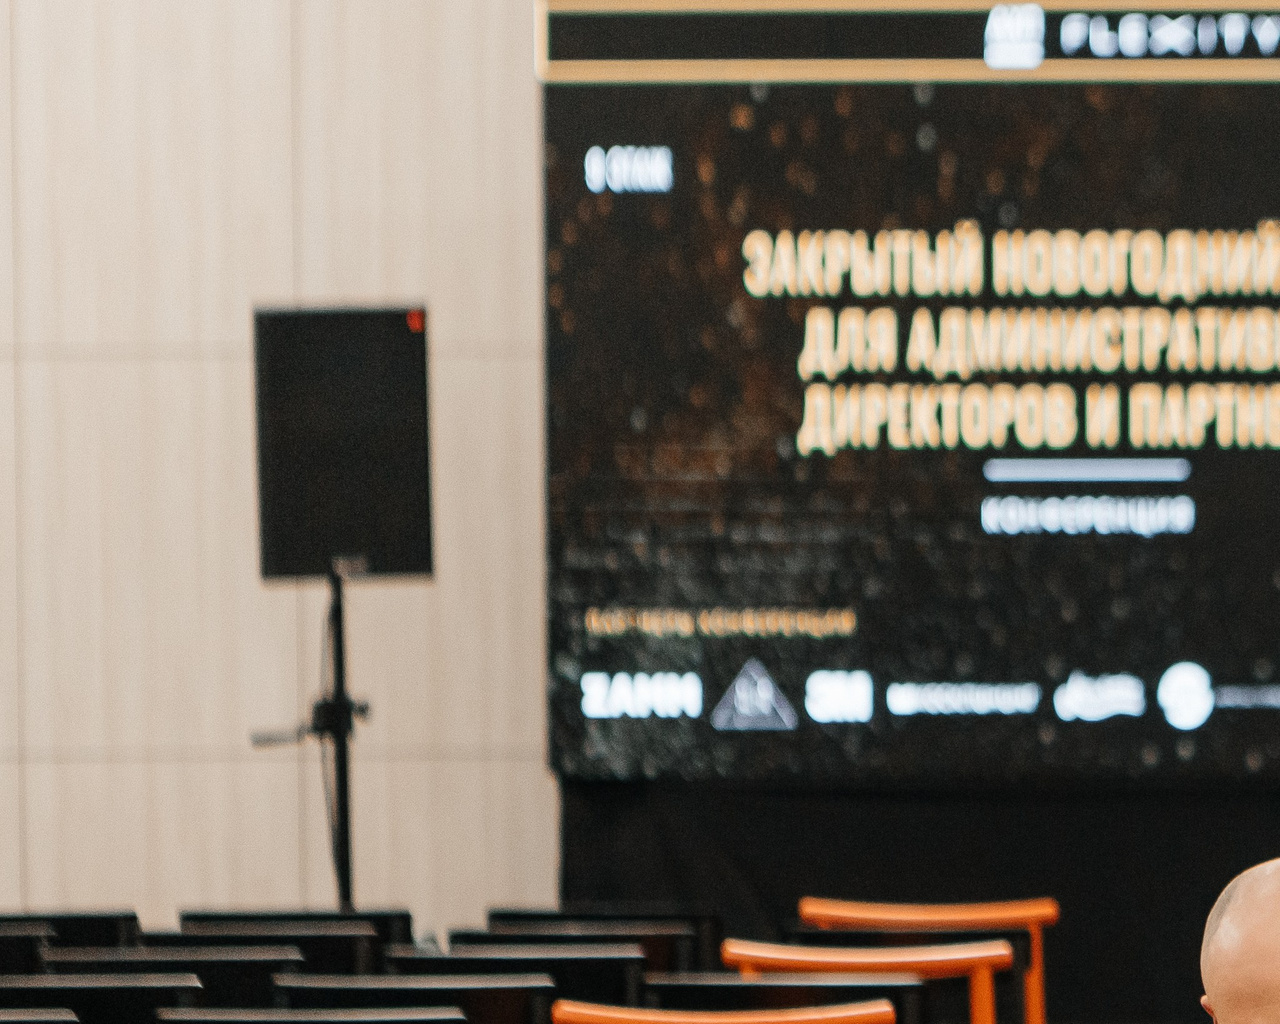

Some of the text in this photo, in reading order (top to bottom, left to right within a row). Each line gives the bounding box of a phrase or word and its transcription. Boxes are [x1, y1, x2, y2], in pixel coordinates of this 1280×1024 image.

[742, 218, 984, 298] ЗАКРЫТЫЙ
[797, 306, 898, 381] ДЛЯ
[796, 382, 1078, 456] ДИРЕКТОРОВ
[1085, 382, 1121, 448] И
